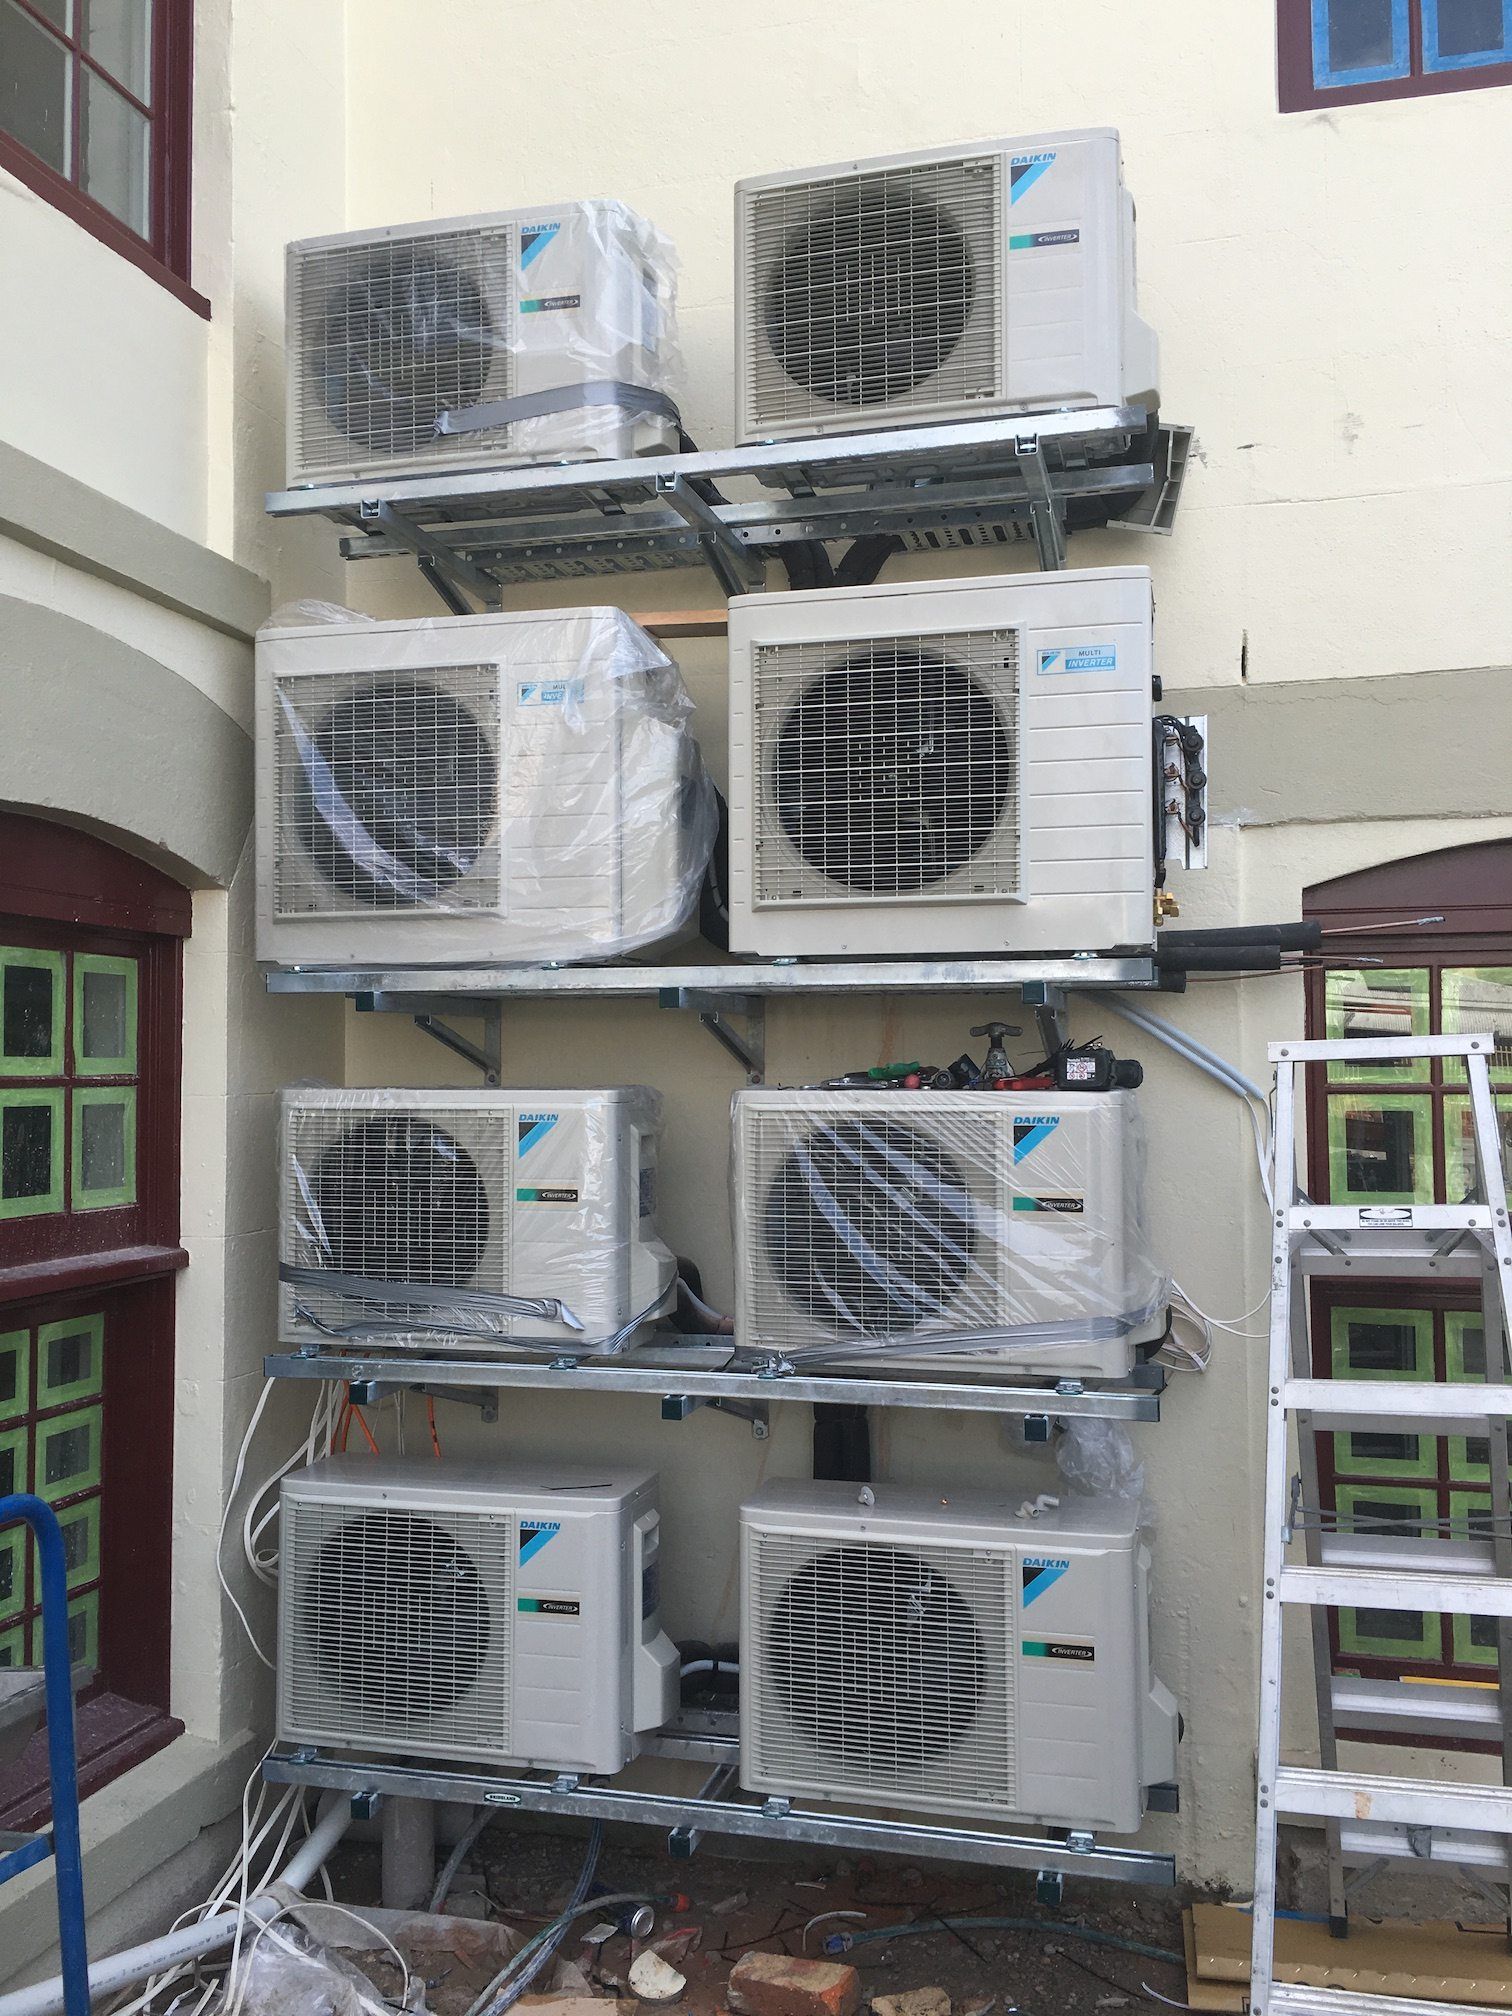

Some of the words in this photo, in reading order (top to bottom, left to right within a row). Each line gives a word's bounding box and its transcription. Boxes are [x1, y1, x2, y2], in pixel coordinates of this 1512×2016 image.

[1010, 152, 1057, 166] DAIKIN
[521, 222, 561, 234] DAIKIN
[1078, 649, 1101, 657] MULTI
[1068, 656, 1113, 668] INVERTER
[519, 1114, 559, 1122] DAIKIN
[1014, 1116, 1060, 1125] DAIKIN
[520, 1521, 561, 1531] DAIKIN
[1023, 1557, 1070, 1569] DAIKIN
